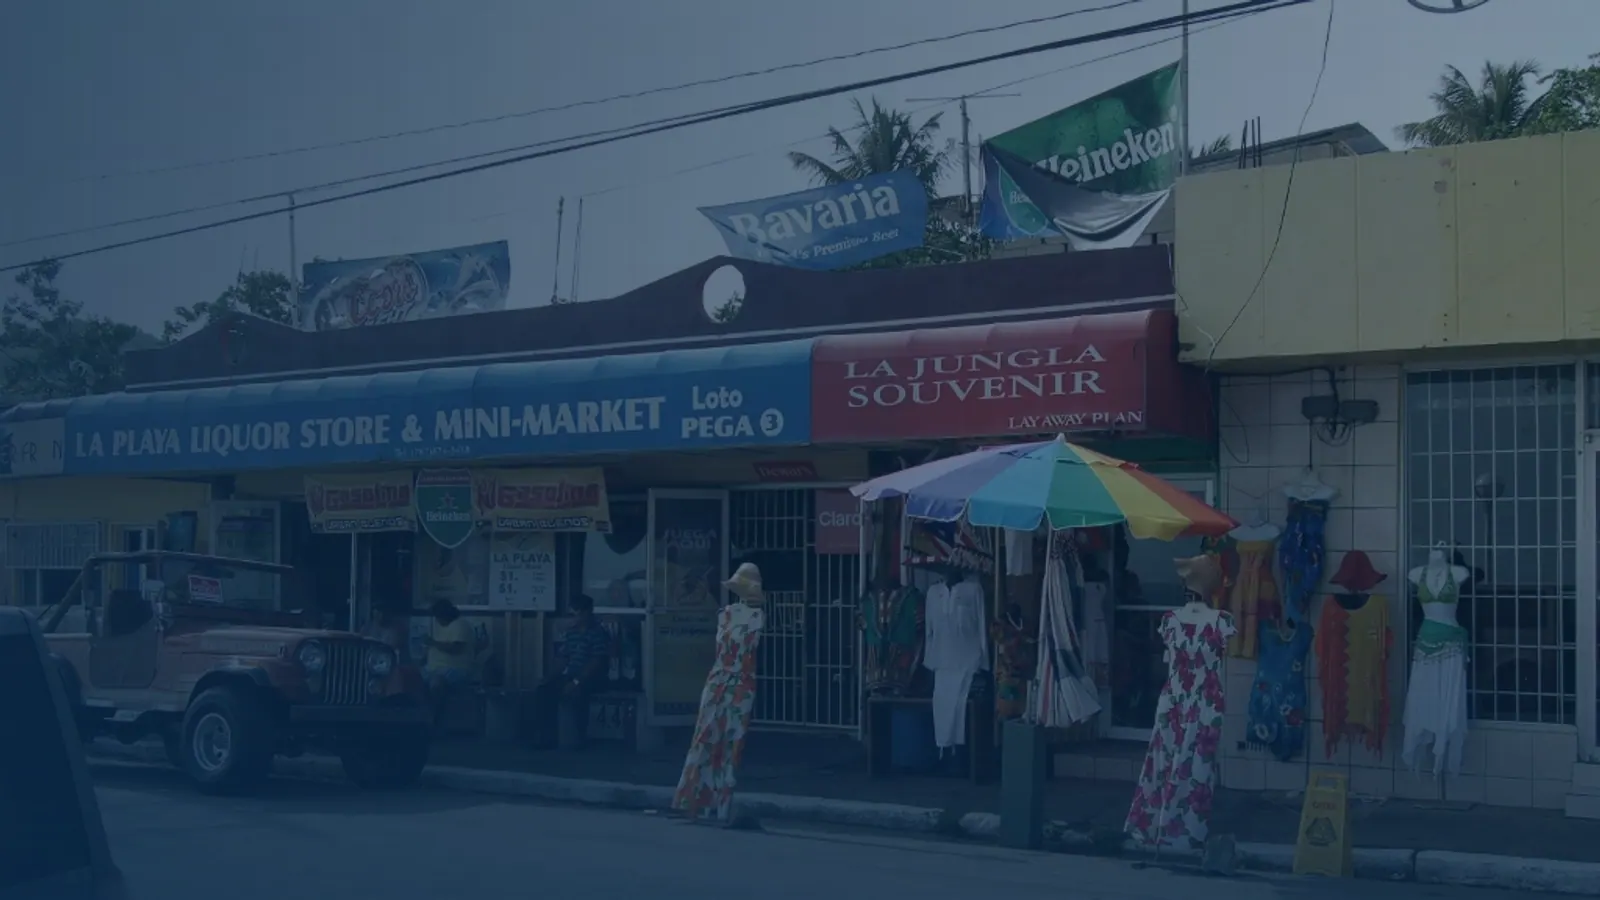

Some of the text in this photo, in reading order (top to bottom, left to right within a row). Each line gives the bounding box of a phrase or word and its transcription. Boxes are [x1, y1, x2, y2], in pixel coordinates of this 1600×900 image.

[729, 183, 901, 243] Bavaria
[843, 343, 1107, 381] LA JUNGLA
[692, 386, 743, 410] Loto
[847, 369, 1107, 408] SOUVENIR
[76, 396, 666, 458] LA PLAYA LIQUOR STORE & MINI-MARKET
[681, 416, 755, 439] PEGA
[426, 511, 471, 522] Heineken
[493, 553, 552, 563] LA PLAYA
